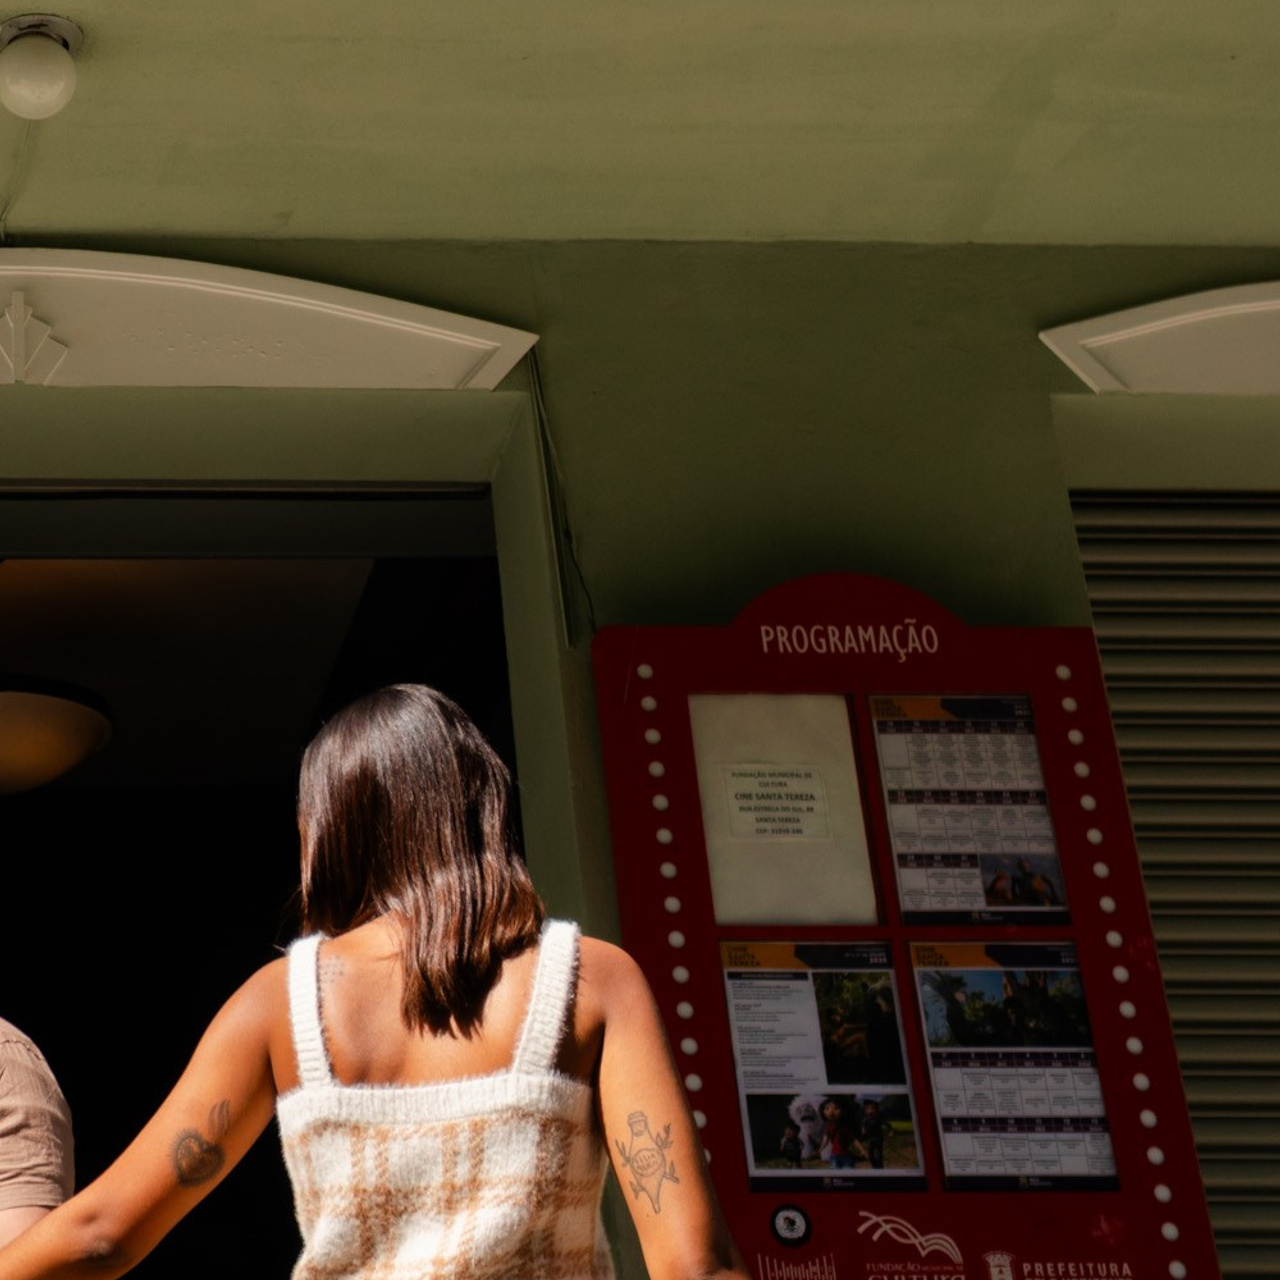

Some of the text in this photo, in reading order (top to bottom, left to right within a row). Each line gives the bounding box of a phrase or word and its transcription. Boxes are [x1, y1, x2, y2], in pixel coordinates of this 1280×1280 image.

[760, 618, 939, 663] PROGRAMAÇÃO
[734, 793, 816, 801] CINE SANTA TEREZA
[1022, 1262, 1132, 1277] PREFEITURA
